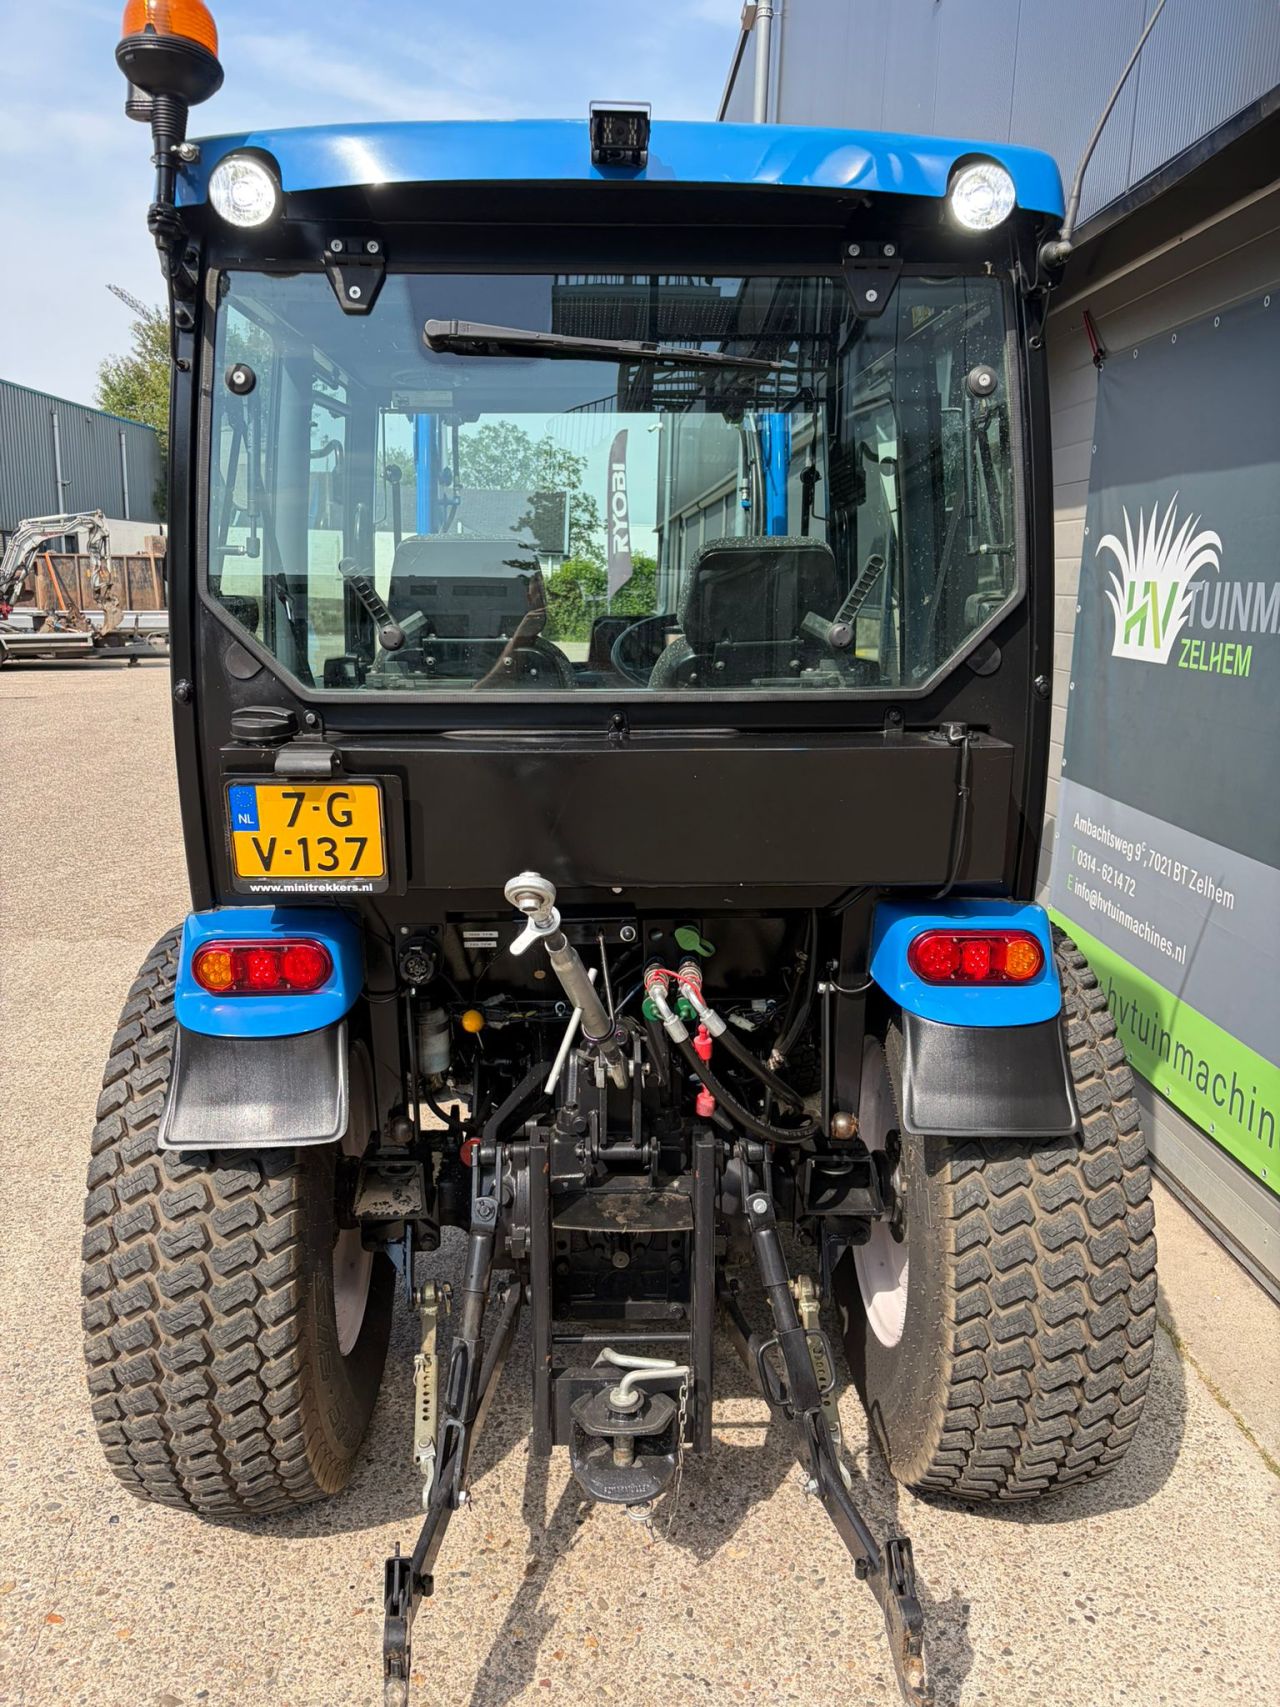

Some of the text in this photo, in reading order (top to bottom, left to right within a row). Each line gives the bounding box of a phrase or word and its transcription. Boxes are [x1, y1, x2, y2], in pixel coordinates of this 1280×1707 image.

[612, 463, 629, 554] RYOBI
[1123, 580, 1280, 649] HV TUINM
[1178, 638, 1253, 677] ZELHEM
[238, 813, 254, 825] NL
[281, 792, 353, 828] 7-G
[251, 837, 368, 872] V-137
[1071, 844, 1077, 861] T
[1077, 849, 1097, 874] 0314
[1073, 812, 1134, 862] Ambachtsweg
[1173, 861, 1189, 885] BT
[1189, 869, 1235, 910] Zelhem
[249, 883, 373, 892] www.minitrekkers.nl
[1067, 873, 1188, 966] E info@hvtuinmachines.nl
[1099, 976, 1280, 1149] hvtuinmachin
